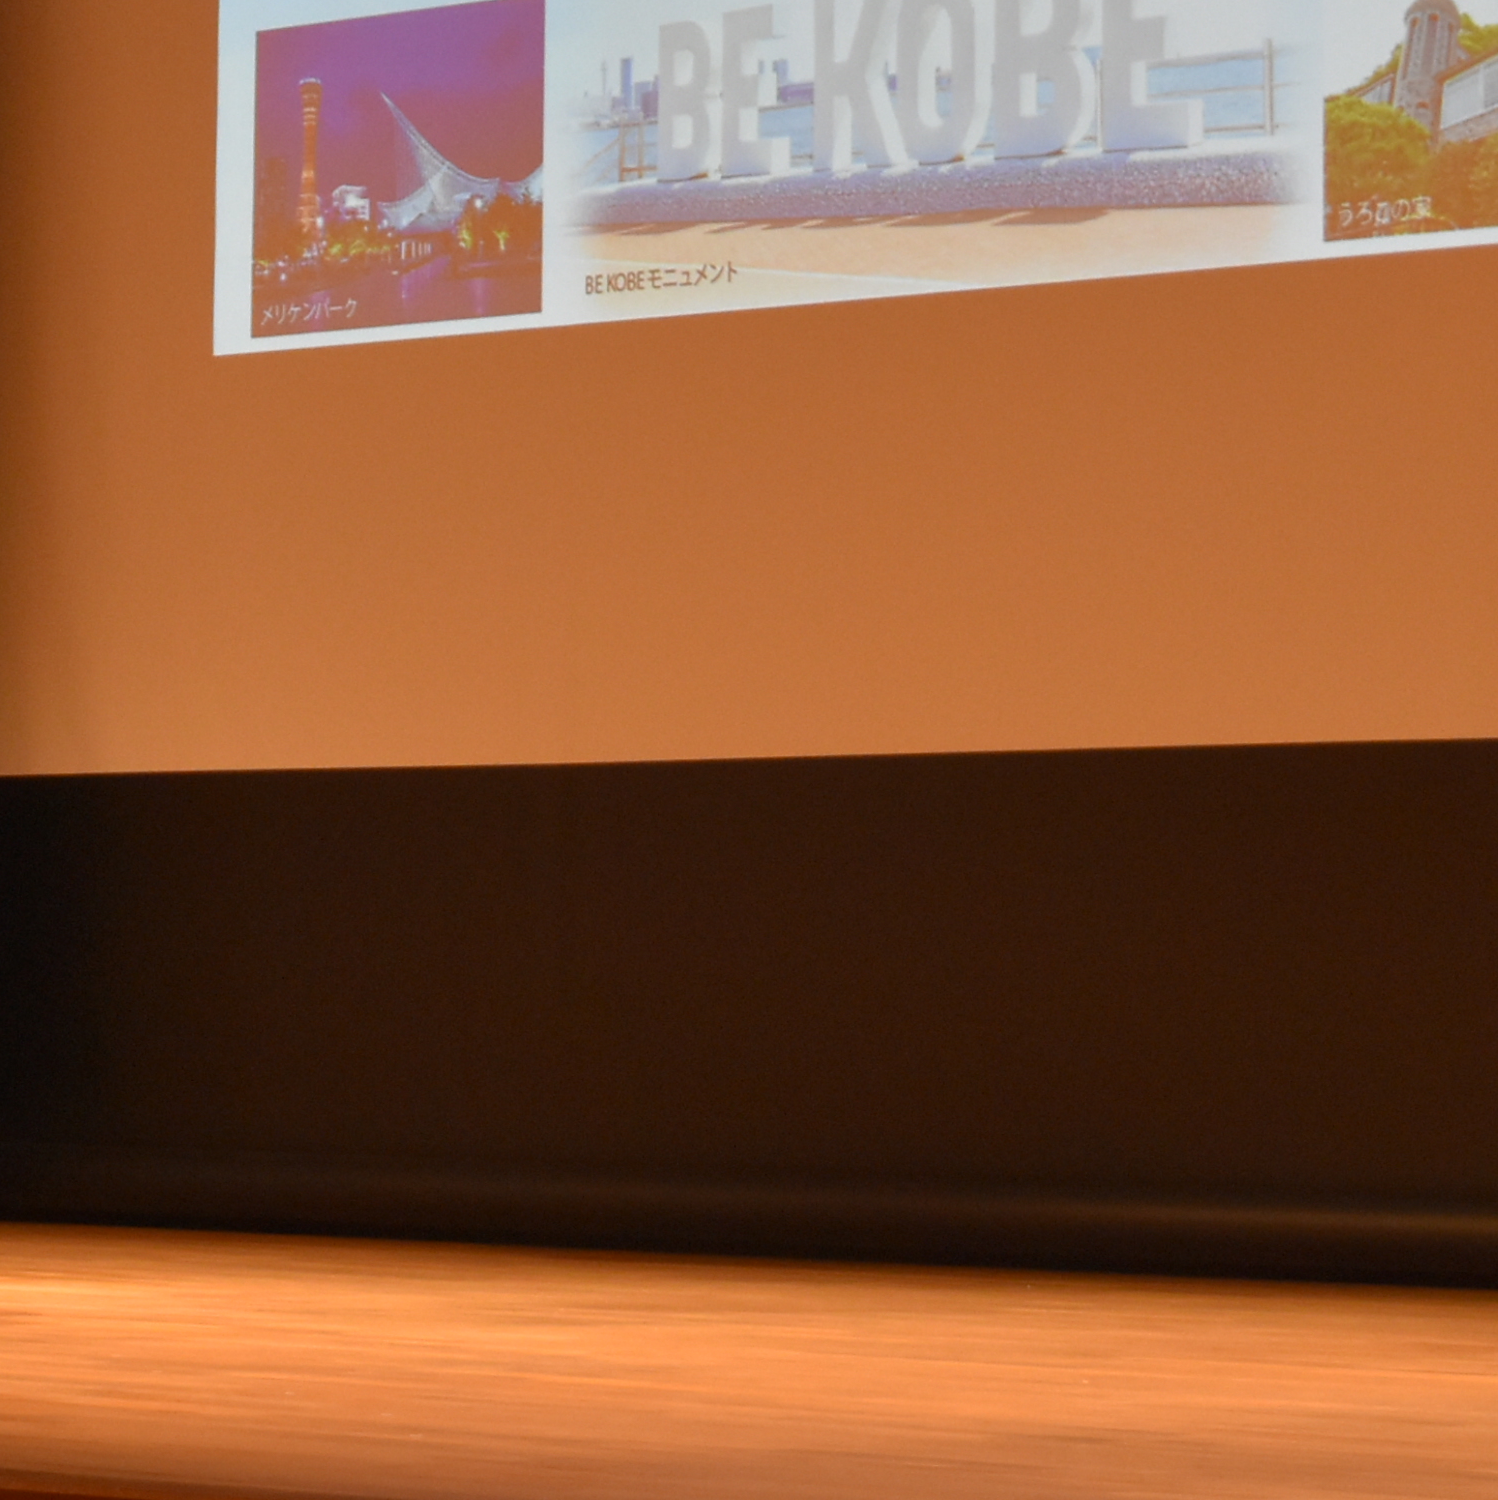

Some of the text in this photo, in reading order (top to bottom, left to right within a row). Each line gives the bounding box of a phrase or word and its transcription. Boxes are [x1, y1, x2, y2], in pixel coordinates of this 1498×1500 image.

[657, 3, 792, 185] BE
[585, 274, 603, 295] BE
[261, 297, 357, 326] メリケンパーク
